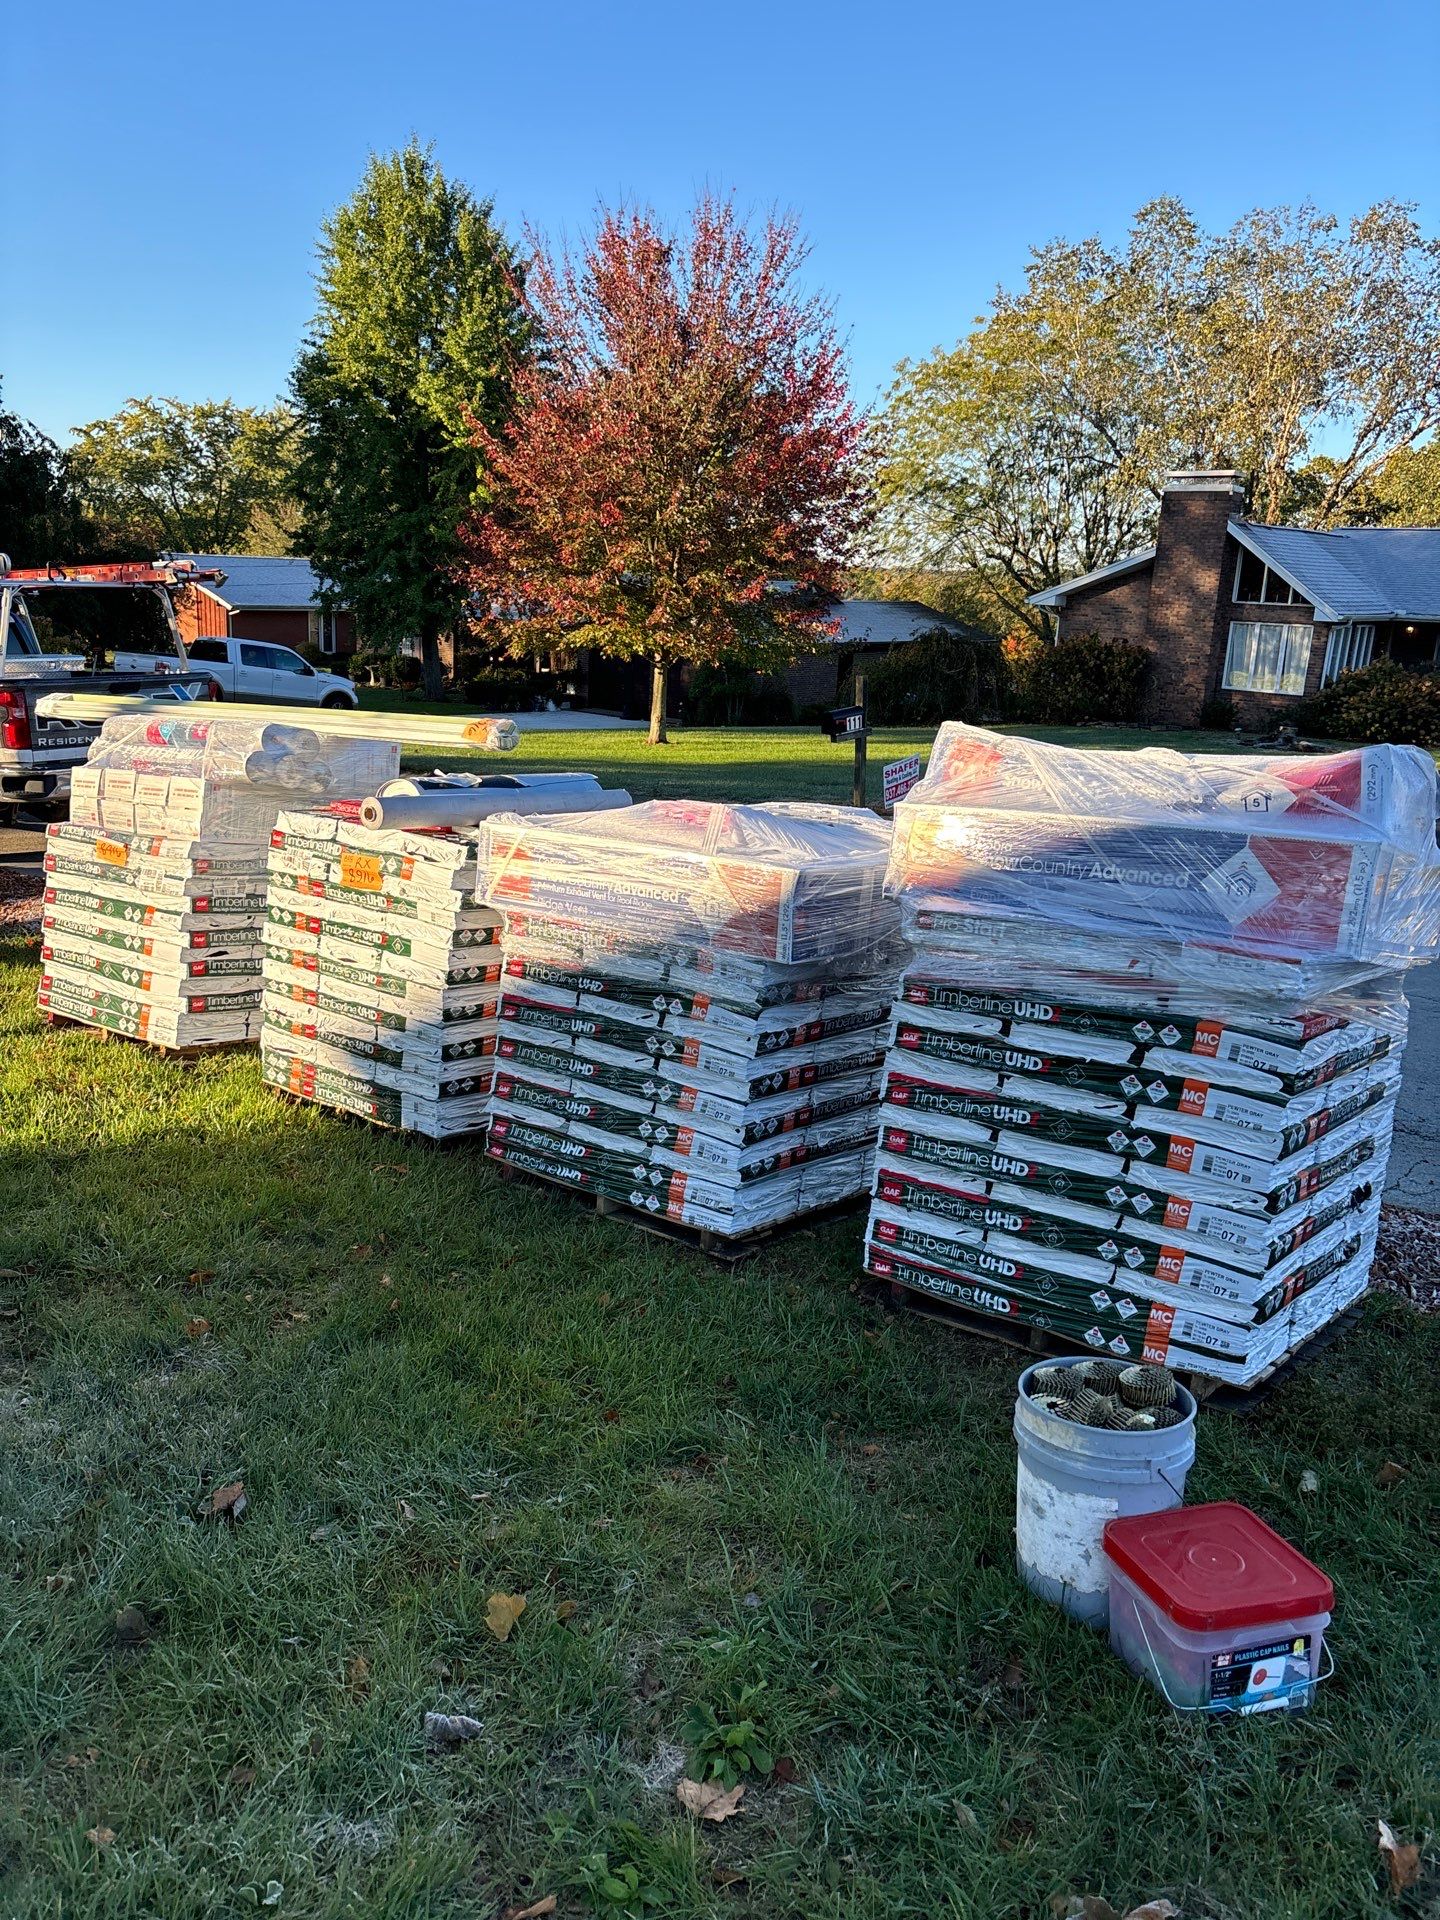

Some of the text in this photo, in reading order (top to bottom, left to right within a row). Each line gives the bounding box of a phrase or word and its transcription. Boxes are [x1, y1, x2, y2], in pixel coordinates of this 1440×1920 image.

[847, 715, 862, 731] 111
[38, 736, 97, 746] RESIDEN
[885, 758, 919, 778] SHAFER
[1253, 799, 1261, 807] 5
[284, 835, 323, 851] Timberline
[402, 861, 413, 872] MC
[325, 885, 366, 903] Timberline
[211, 897, 259, 907] Timberline
[209, 932, 256, 942] Timberline
[207, 960, 256, 969] Timberline
[525, 963, 577, 985] Timberline
[207, 994, 255, 1005] Timberline
[692, 1006, 706, 1018] MC
[903, 1033, 919, 1041] GAF
[1195, 1031, 1219, 1045] MC
[517, 1044, 568, 1067] Timberline
[684, 1045, 698, 1056] MC
[1253, 1060, 1266, 1069] 07
[314, 1086, 355, 1107] Timberline
[514, 1084, 565, 1108] Timberline
[680, 1092, 695, 1103] MC
[1181, 1089, 1205, 1105] MC
[892, 1091, 909, 1099] GAF
[914, 1089, 991, 1116] Timberline
[714, 1111, 723, 1119] 07
[1237, 1120, 1251, 1128] 07
[510, 1124, 560, 1149] Timberline
[678, 1131, 692, 1143] MC
[890, 1135, 906, 1144] GAF
[912, 1135, 990, 1166] Timberline
[1169, 1143, 1192, 1157] MC
[712, 1153, 720, 1162] 07
[1226, 1169, 1239, 1180] 07
[671, 1177, 686, 1187] MC
[705, 1197, 713, 1205] 07
[883, 1186, 900, 1197] GAF
[906, 1185, 983, 1220] Timberline
[668, 1202, 683, 1213] MC
[1167, 1202, 1190, 1216] MC
[880, 1226, 896, 1234] GAF
[1221, 1230, 1235, 1241] 07
[875, 1263, 892, 1271] GAF
[1158, 1256, 1182, 1272] MC
[1214, 1286, 1227, 1297] 07
[1150, 1308, 1173, 1324] MC
[1205, 1335, 1219, 1346] 07
[1143, 1346, 1166, 1362] MC
[1234, 1651, 1259, 1661] PLASTIC
[1260, 1648, 1271, 1657] CAP
[1272, 1644, 1289, 1653] NAILS
